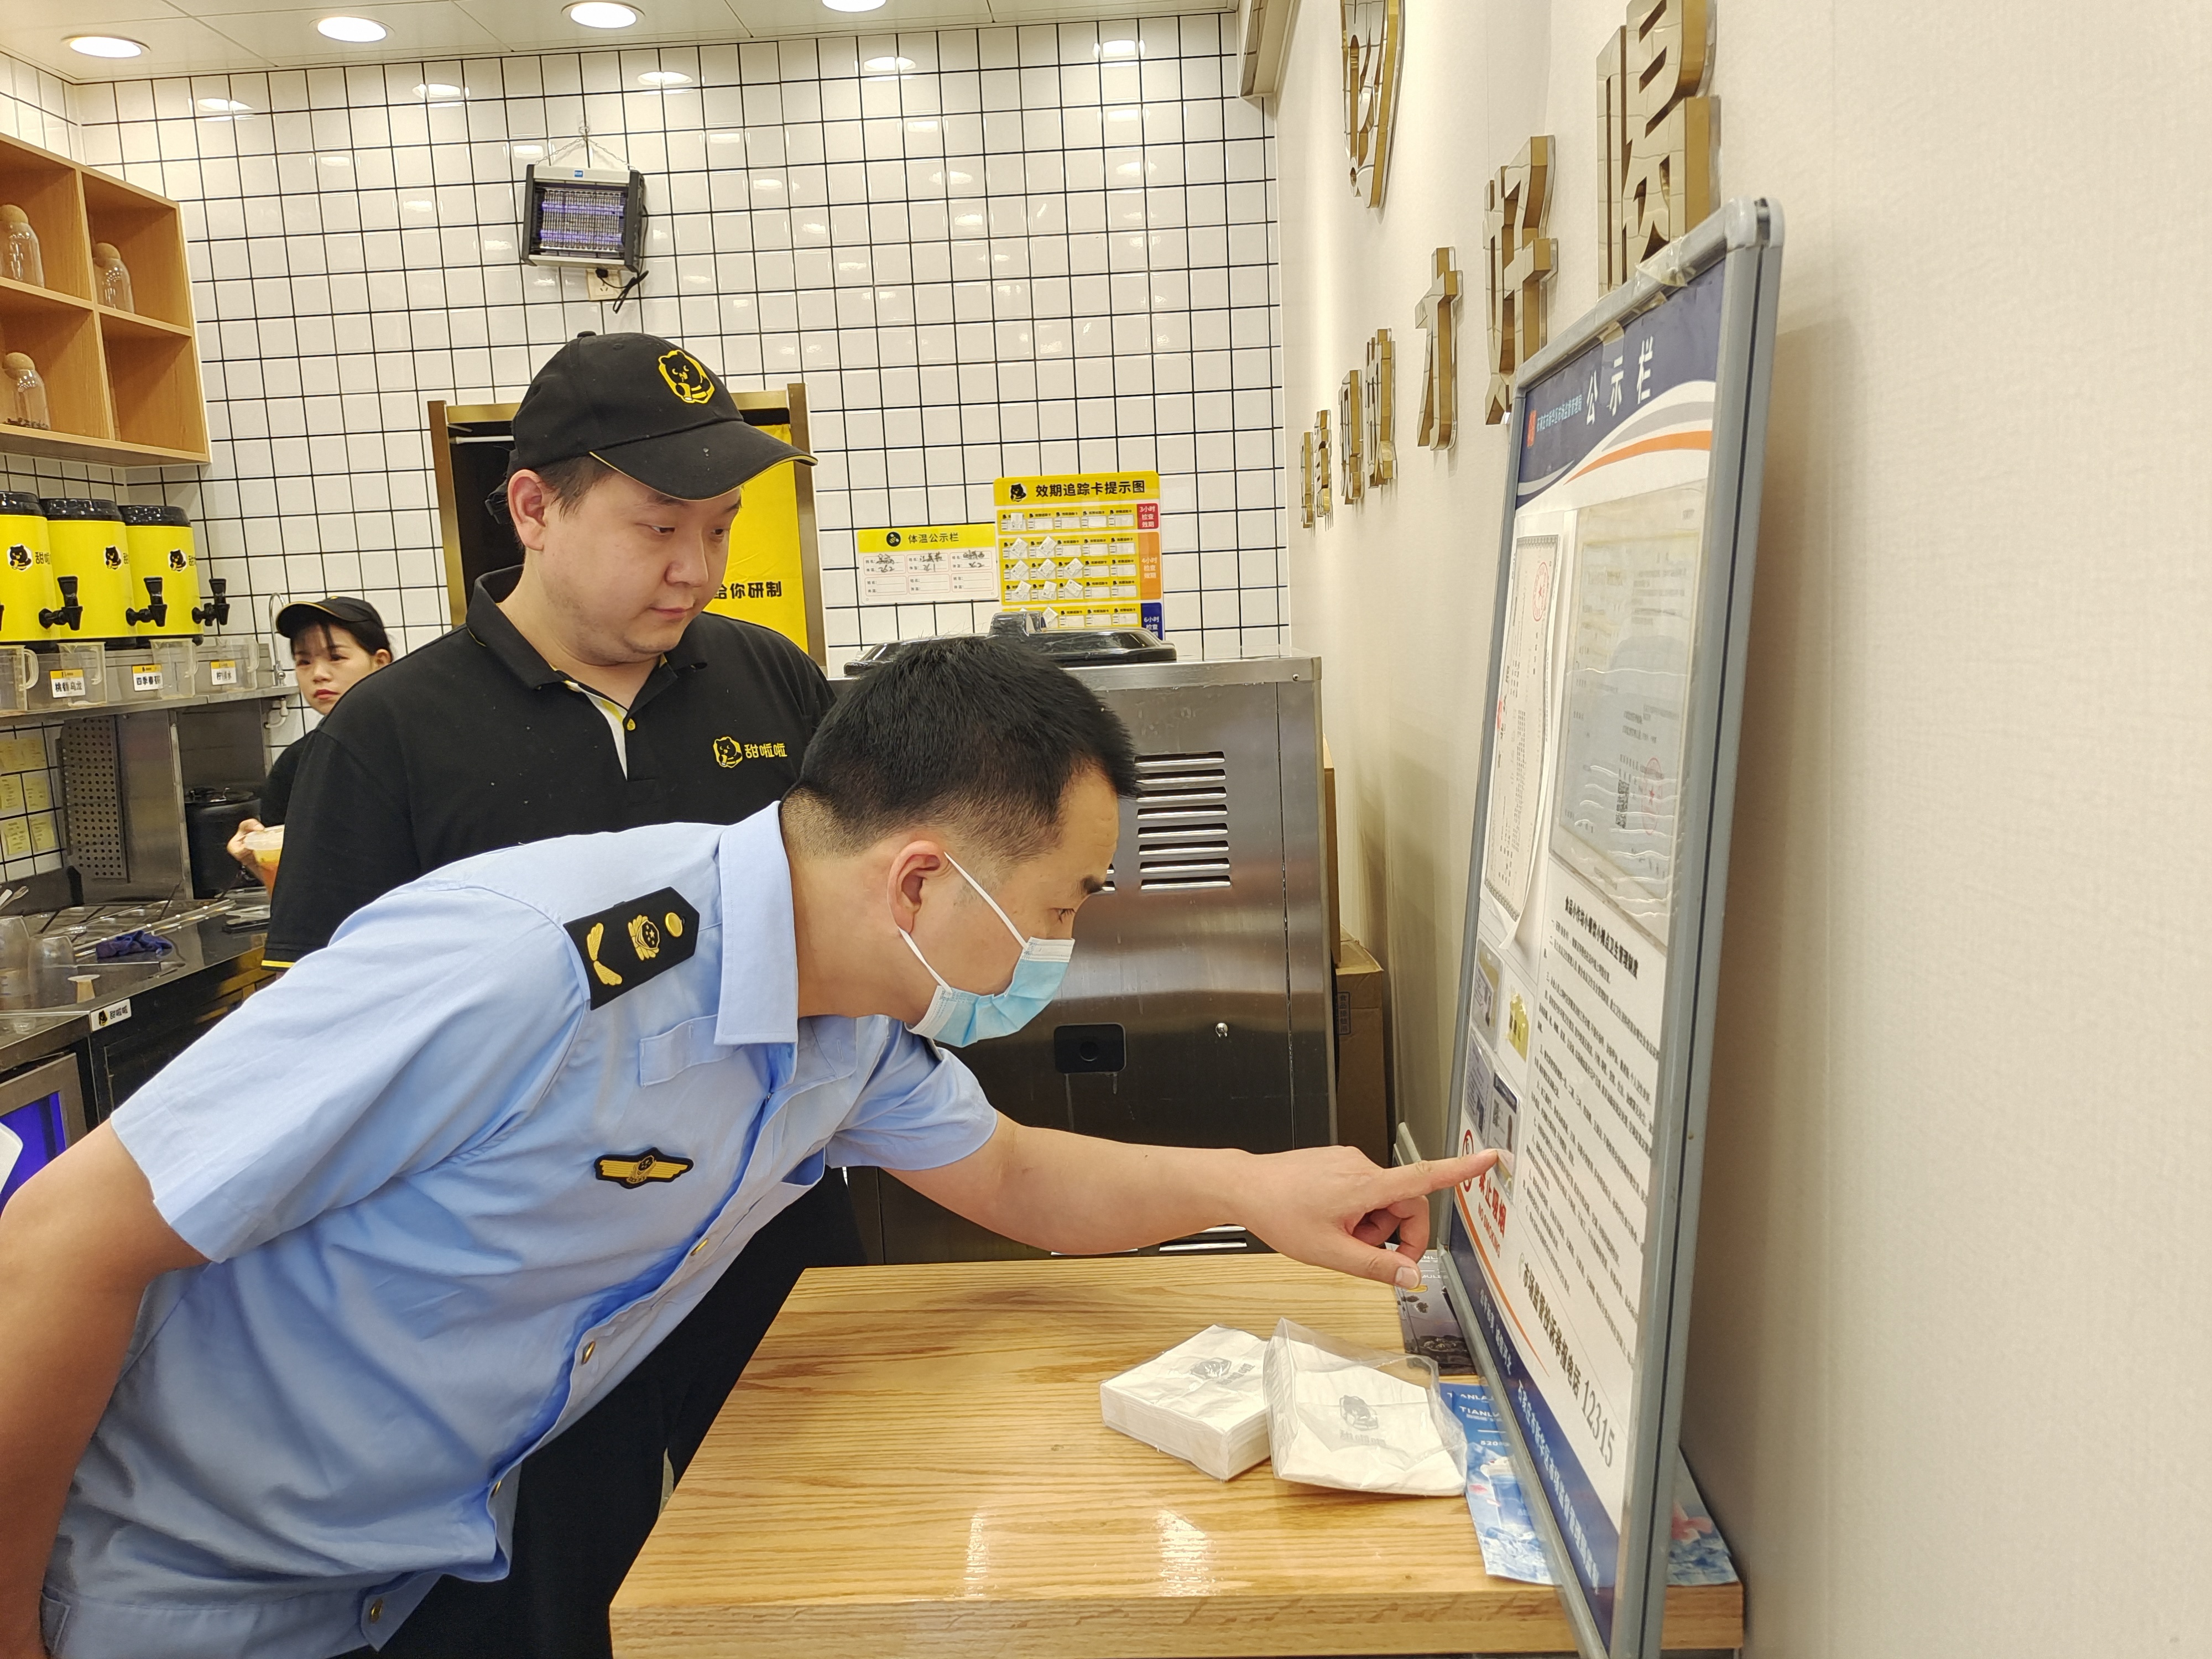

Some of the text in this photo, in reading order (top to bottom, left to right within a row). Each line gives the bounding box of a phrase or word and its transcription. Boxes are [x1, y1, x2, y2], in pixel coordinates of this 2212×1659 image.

[1586, 335, 1653, 425] 公示栏
[1036, 480, 1145, 497] 效期追踪卡提示图
[908, 533, 959, 544] 体温公示栏
[744, 743, 787, 759] 甜啦啦
[1522, 1261, 1615, 1468] 市场监管投诉举报电话 12315
